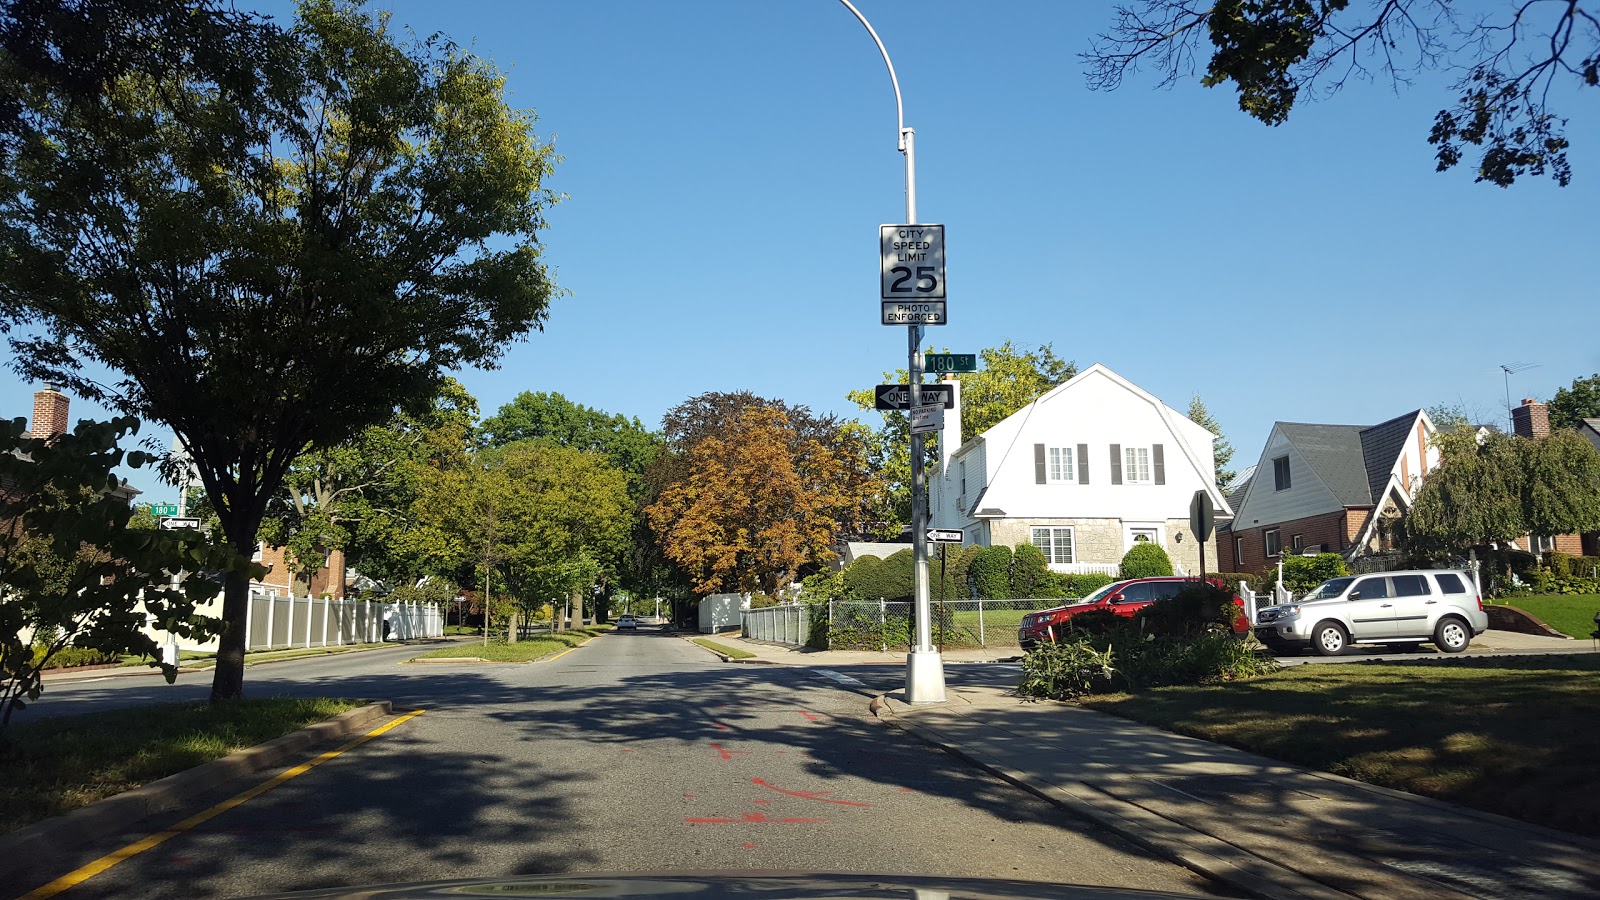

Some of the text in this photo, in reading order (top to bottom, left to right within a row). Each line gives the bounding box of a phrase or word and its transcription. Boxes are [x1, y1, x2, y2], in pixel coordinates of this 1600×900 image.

[899, 230, 924, 239] CITY
[893, 242, 930, 250] SPEED
[897, 253, 927, 262] LIMIT
[890, 266, 938, 293] 25
[888, 313, 940, 321] ENFORCED
[930, 356, 955, 371] 180
[888, 392, 909, 402] ONE
[155, 506, 168, 514] 180
